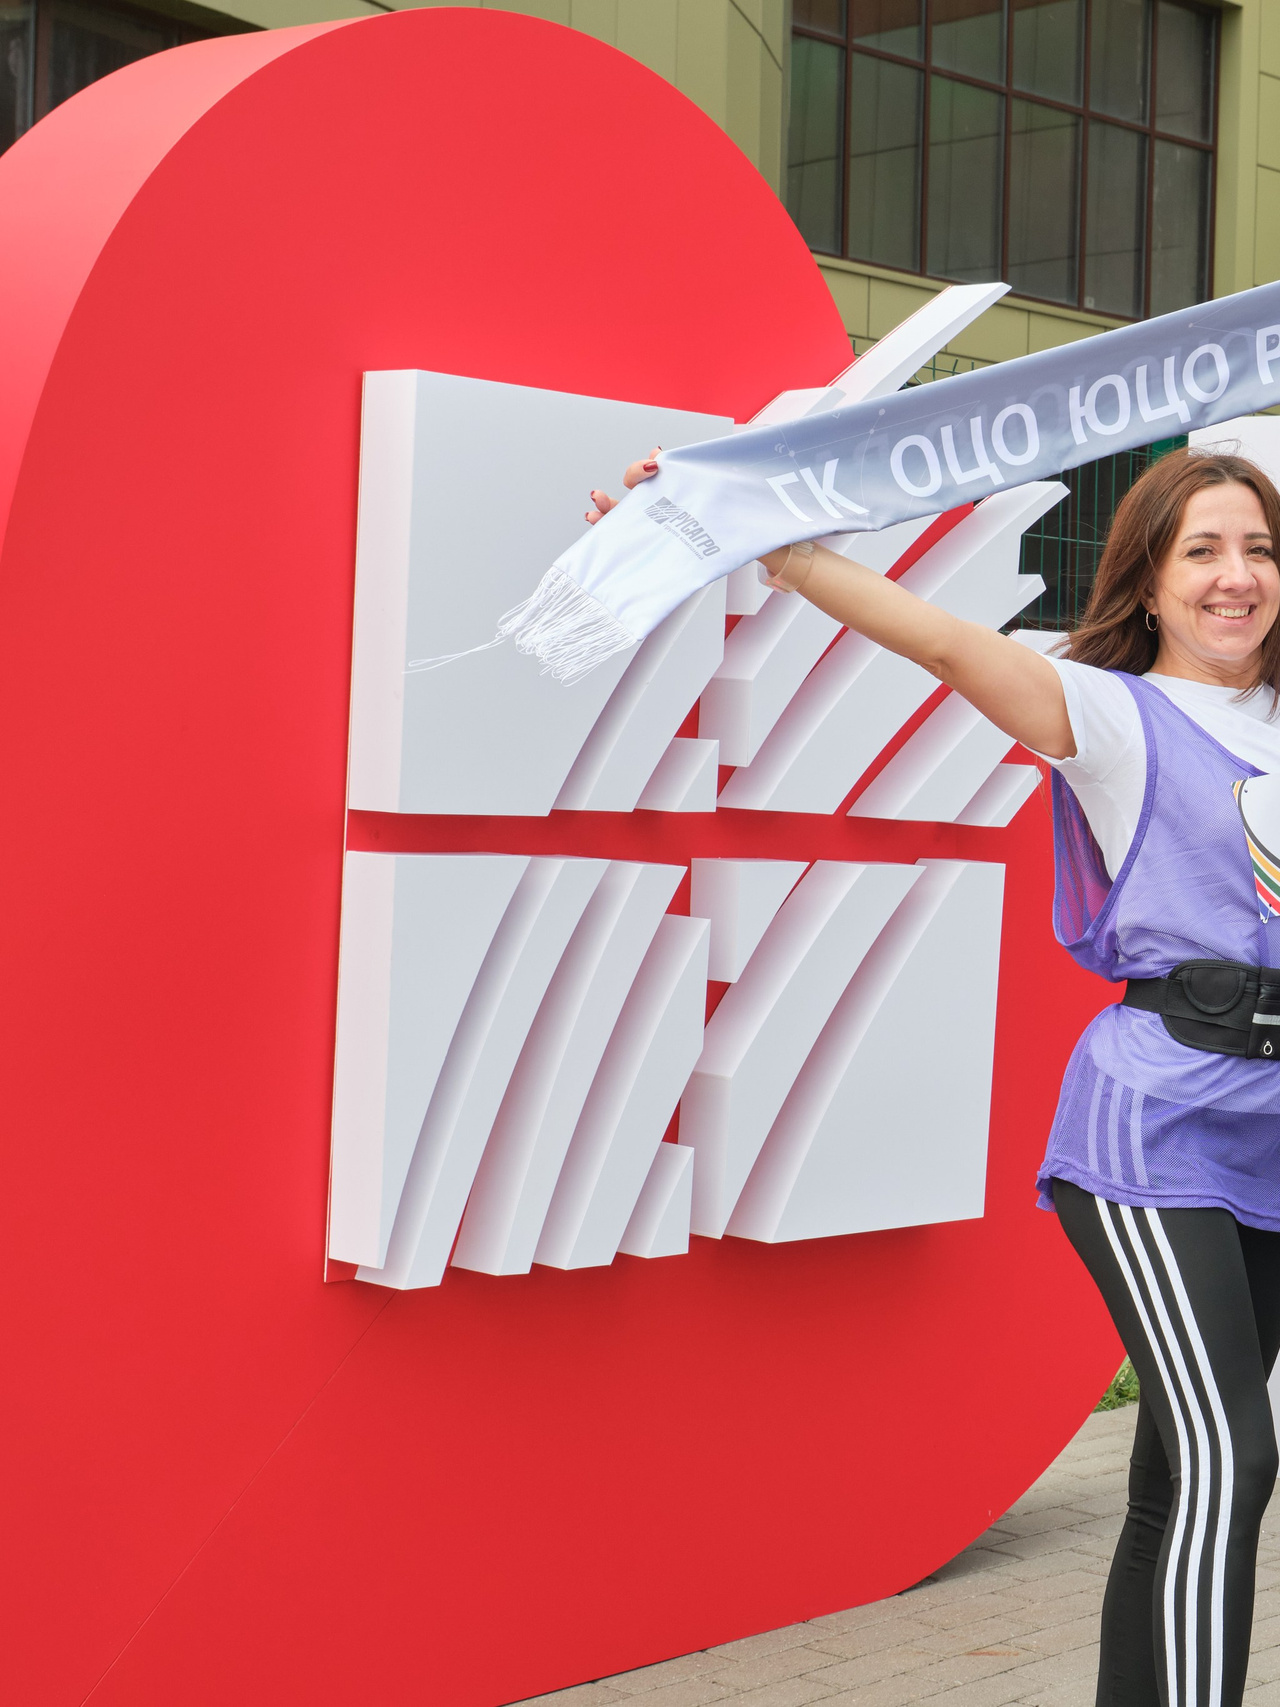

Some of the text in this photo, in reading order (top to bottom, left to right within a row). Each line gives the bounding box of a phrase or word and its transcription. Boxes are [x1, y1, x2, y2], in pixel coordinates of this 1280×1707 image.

[765, 458, 870, 522] ГК
[890, 403, 1040, 497] ОЦО
[1069, 343, 1230, 445] ЮЦО
[669, 511, 721, 557] РУСАГРО
